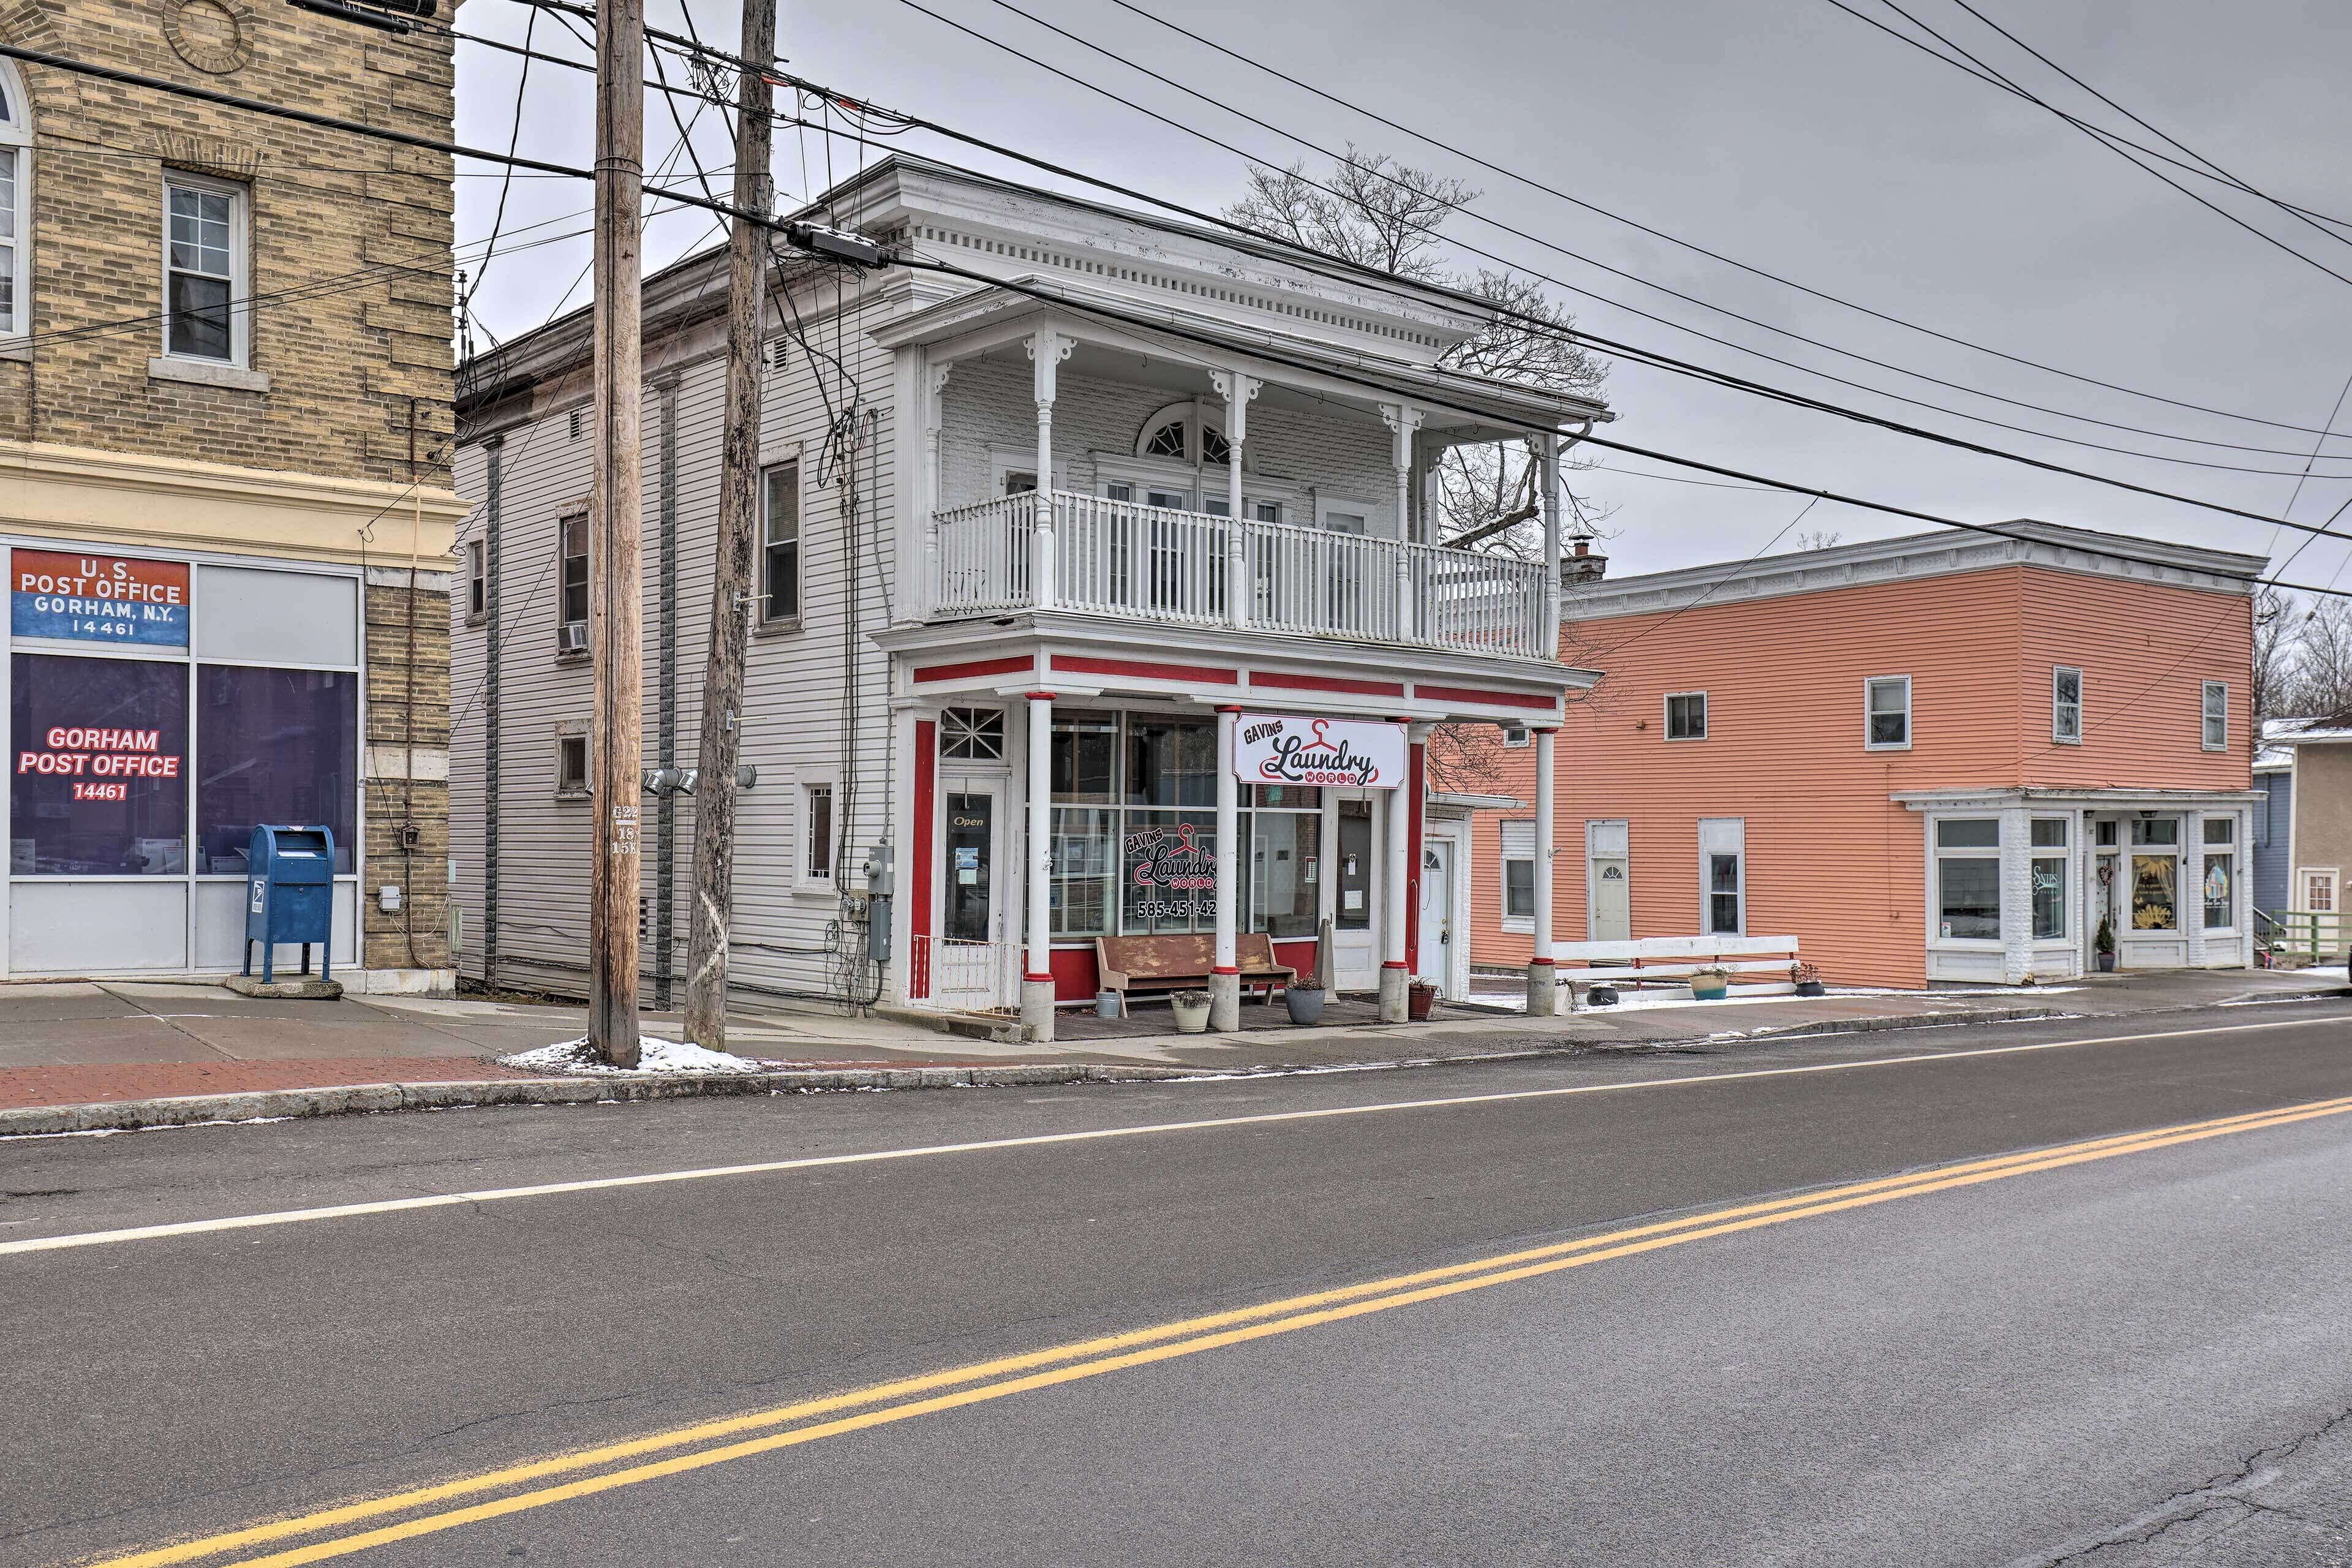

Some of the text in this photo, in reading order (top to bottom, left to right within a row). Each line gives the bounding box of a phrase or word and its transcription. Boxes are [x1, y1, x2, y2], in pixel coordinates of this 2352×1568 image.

[21, 573, 181, 604] POST OFFICE
[34, 596, 173, 622] GORHAM, N.Y.
[74, 619, 133, 635] 14461
[47, 727, 159, 752] GORHAM
[1243, 720, 1283, 745] GAVINS
[18, 752, 179, 777] POST OFFICE
[1264, 735, 1374, 786] Laundry
[1305, 772, 1357, 783] WORLD
[74, 783, 127, 800] 14461
[613, 805, 638, 818] G22
[954, 816, 983, 827] Open
[612, 842, 636, 854] 15K
[1125, 827, 1164, 854] GAVINS
[1172, 878, 1213, 889] WORLD
[1137, 900, 1216, 918] 585-451-42
